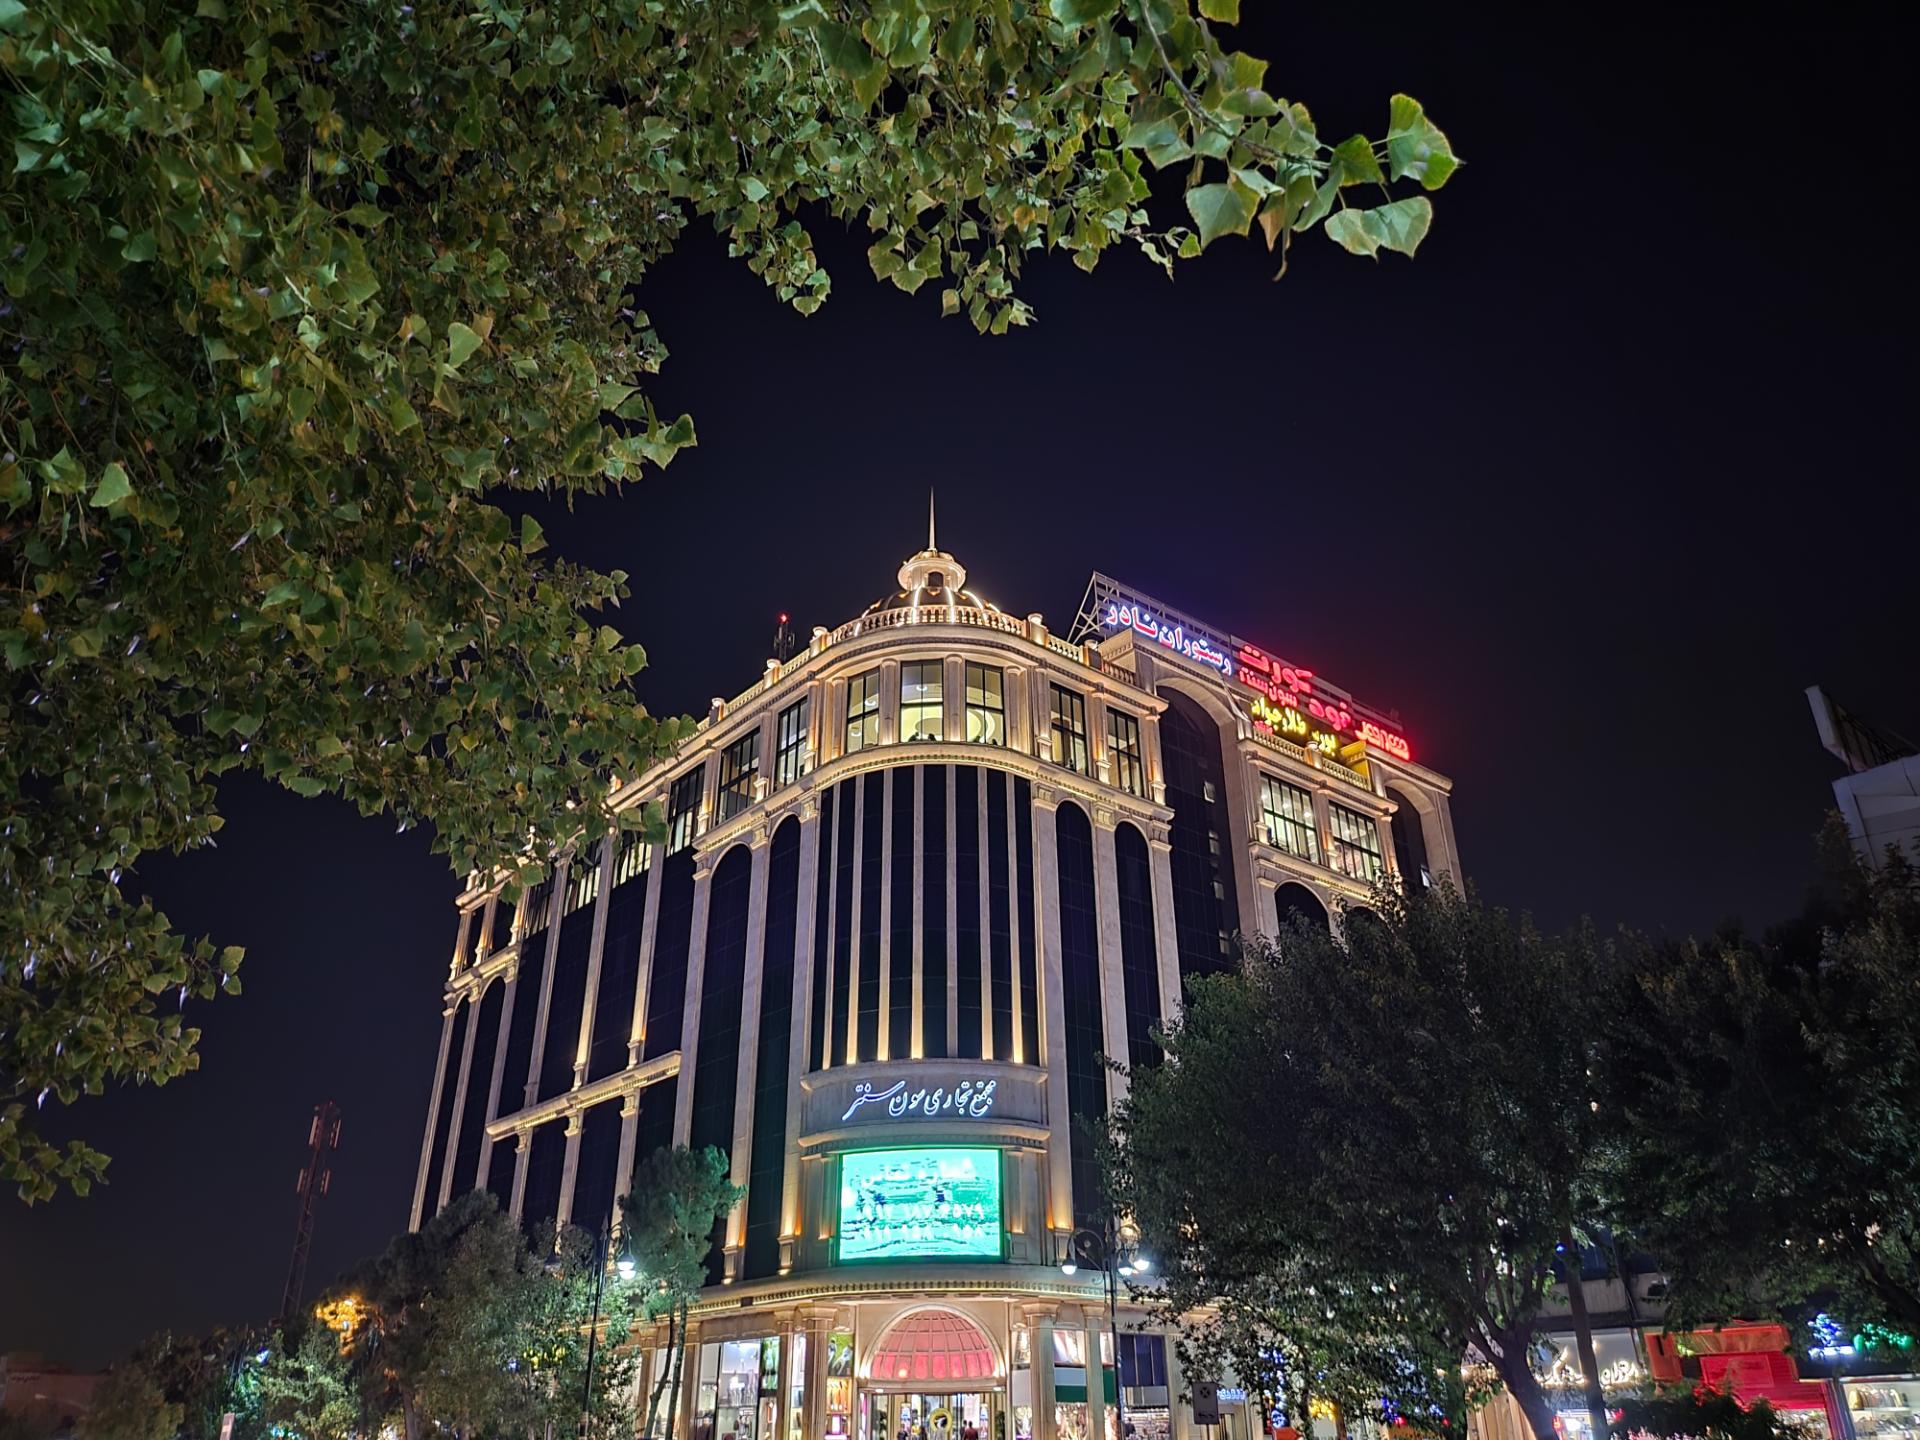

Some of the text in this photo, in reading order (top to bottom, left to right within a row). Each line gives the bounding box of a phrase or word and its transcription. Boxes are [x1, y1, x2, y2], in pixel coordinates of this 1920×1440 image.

[1106, 605, 1232, 676] رستوران نادر
[1239, 645, 1351, 731] فود کورت
[841, 1080, 997, 1121] مجتمع تجاری سون سنتر
